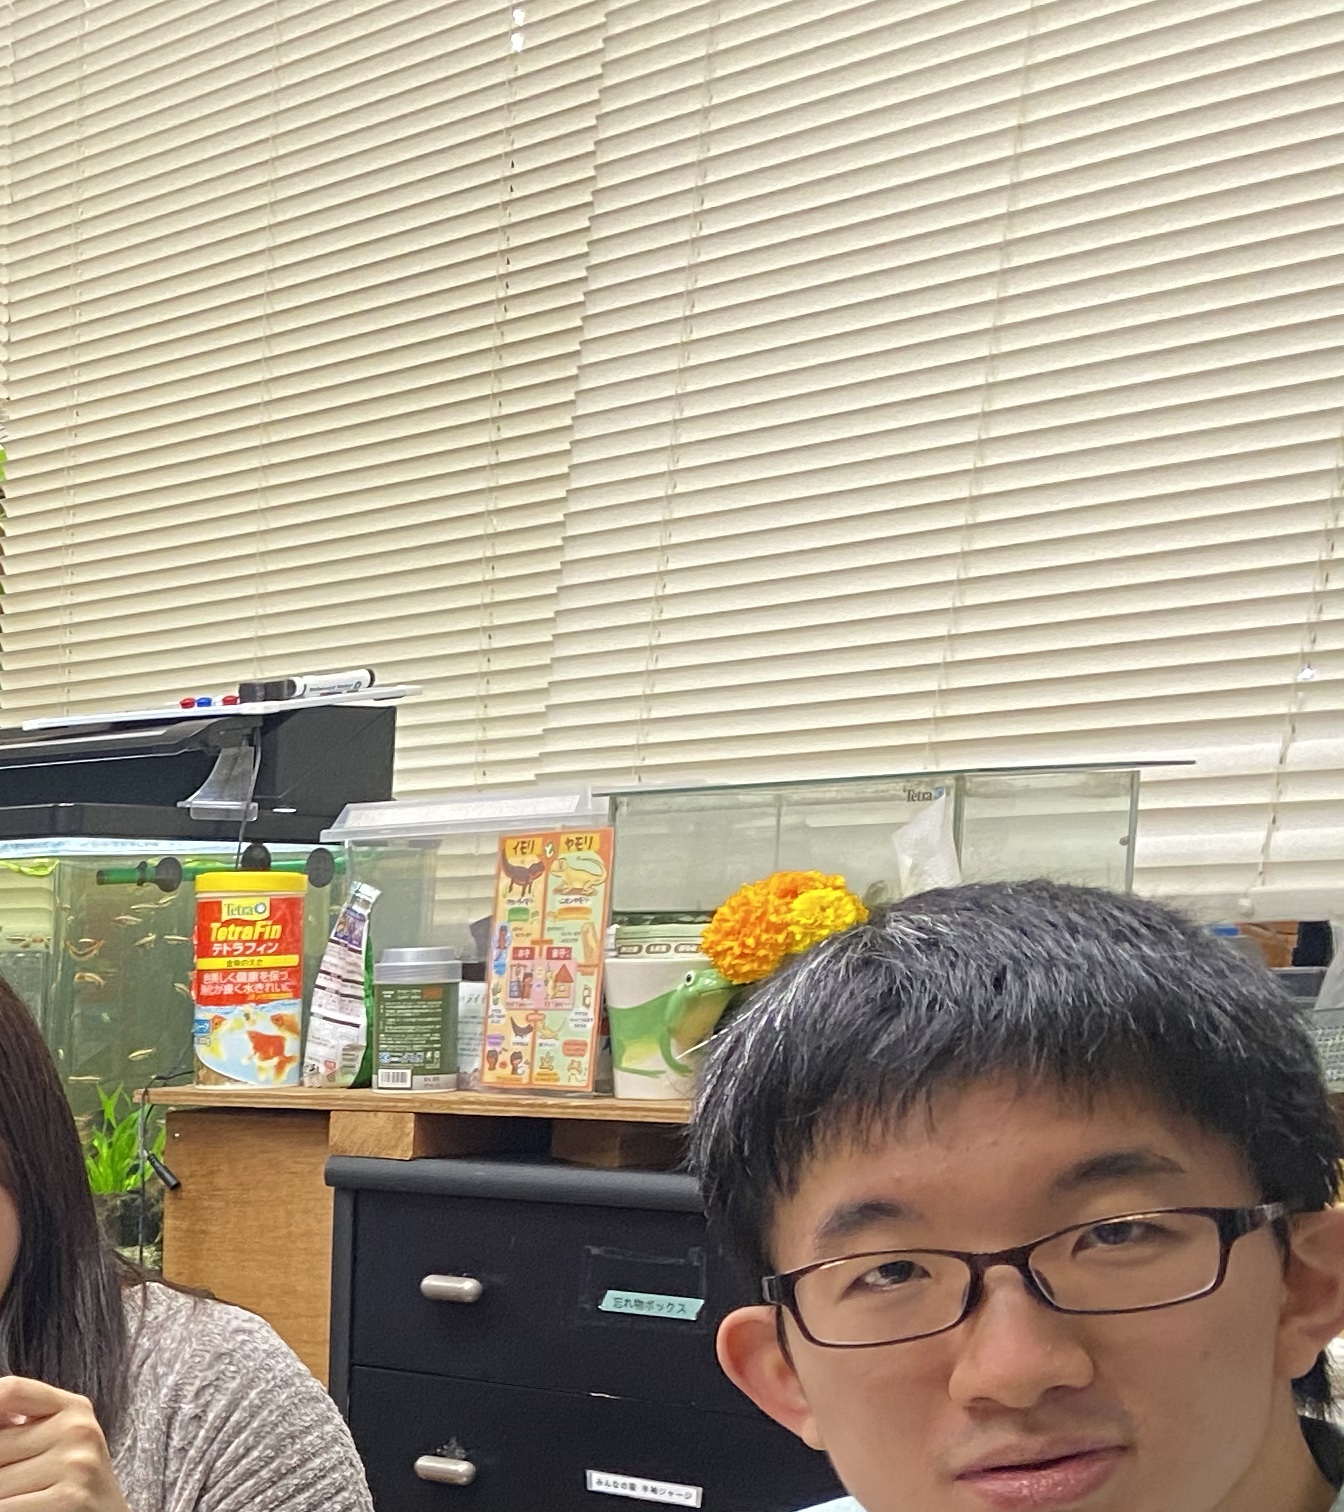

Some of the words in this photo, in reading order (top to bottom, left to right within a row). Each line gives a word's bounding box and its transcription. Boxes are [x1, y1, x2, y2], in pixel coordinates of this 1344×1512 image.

[512, 839, 536, 856] イモリ
[565, 836, 594, 851] ヤモリ
[224, 902, 254, 916] Tetra
[210, 920, 283, 941] TetraFin
[212, 943, 280, 956] テトラフィン
[613, 1297, 687, 1314] 忘れ物ボックス
